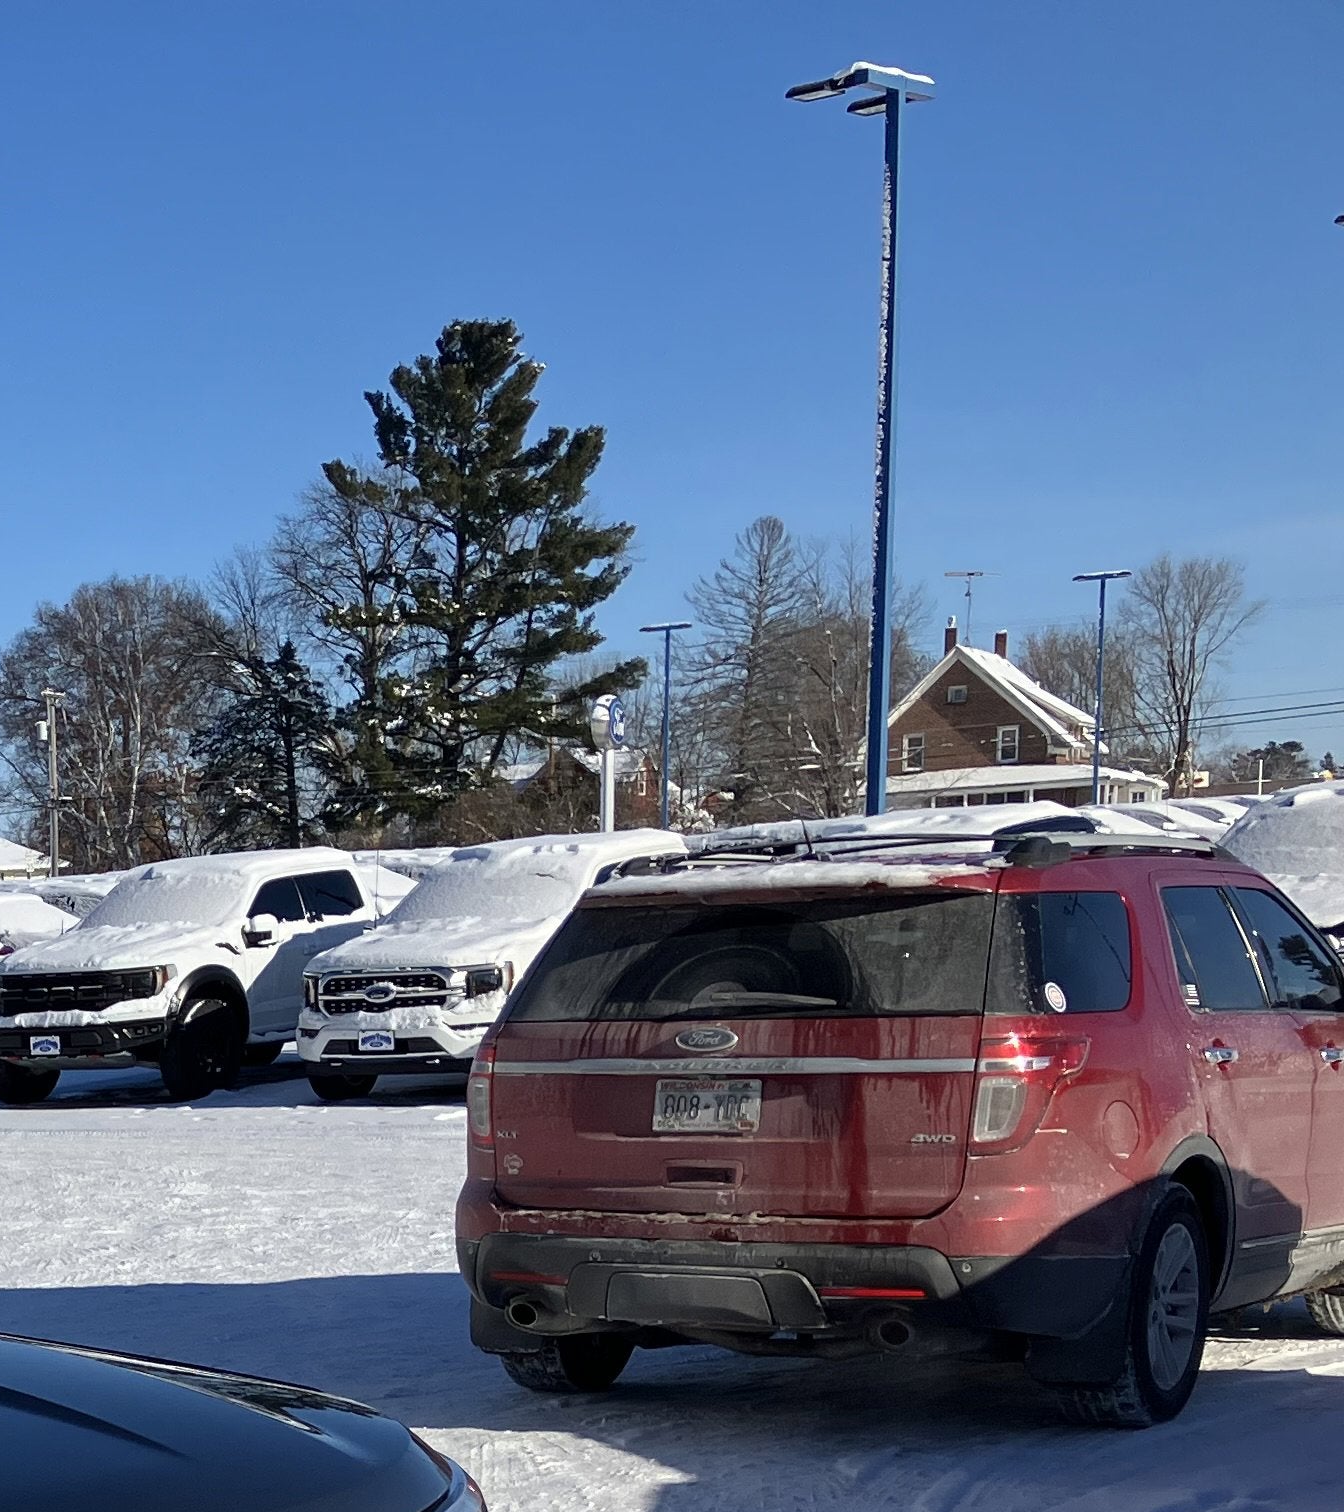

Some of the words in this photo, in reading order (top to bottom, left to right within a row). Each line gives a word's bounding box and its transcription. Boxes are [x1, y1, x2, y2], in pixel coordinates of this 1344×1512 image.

[688, 1031, 721, 1046] Ford
[496, 1129, 518, 1139] XLT
[910, 1133, 957, 1143] 4WD
